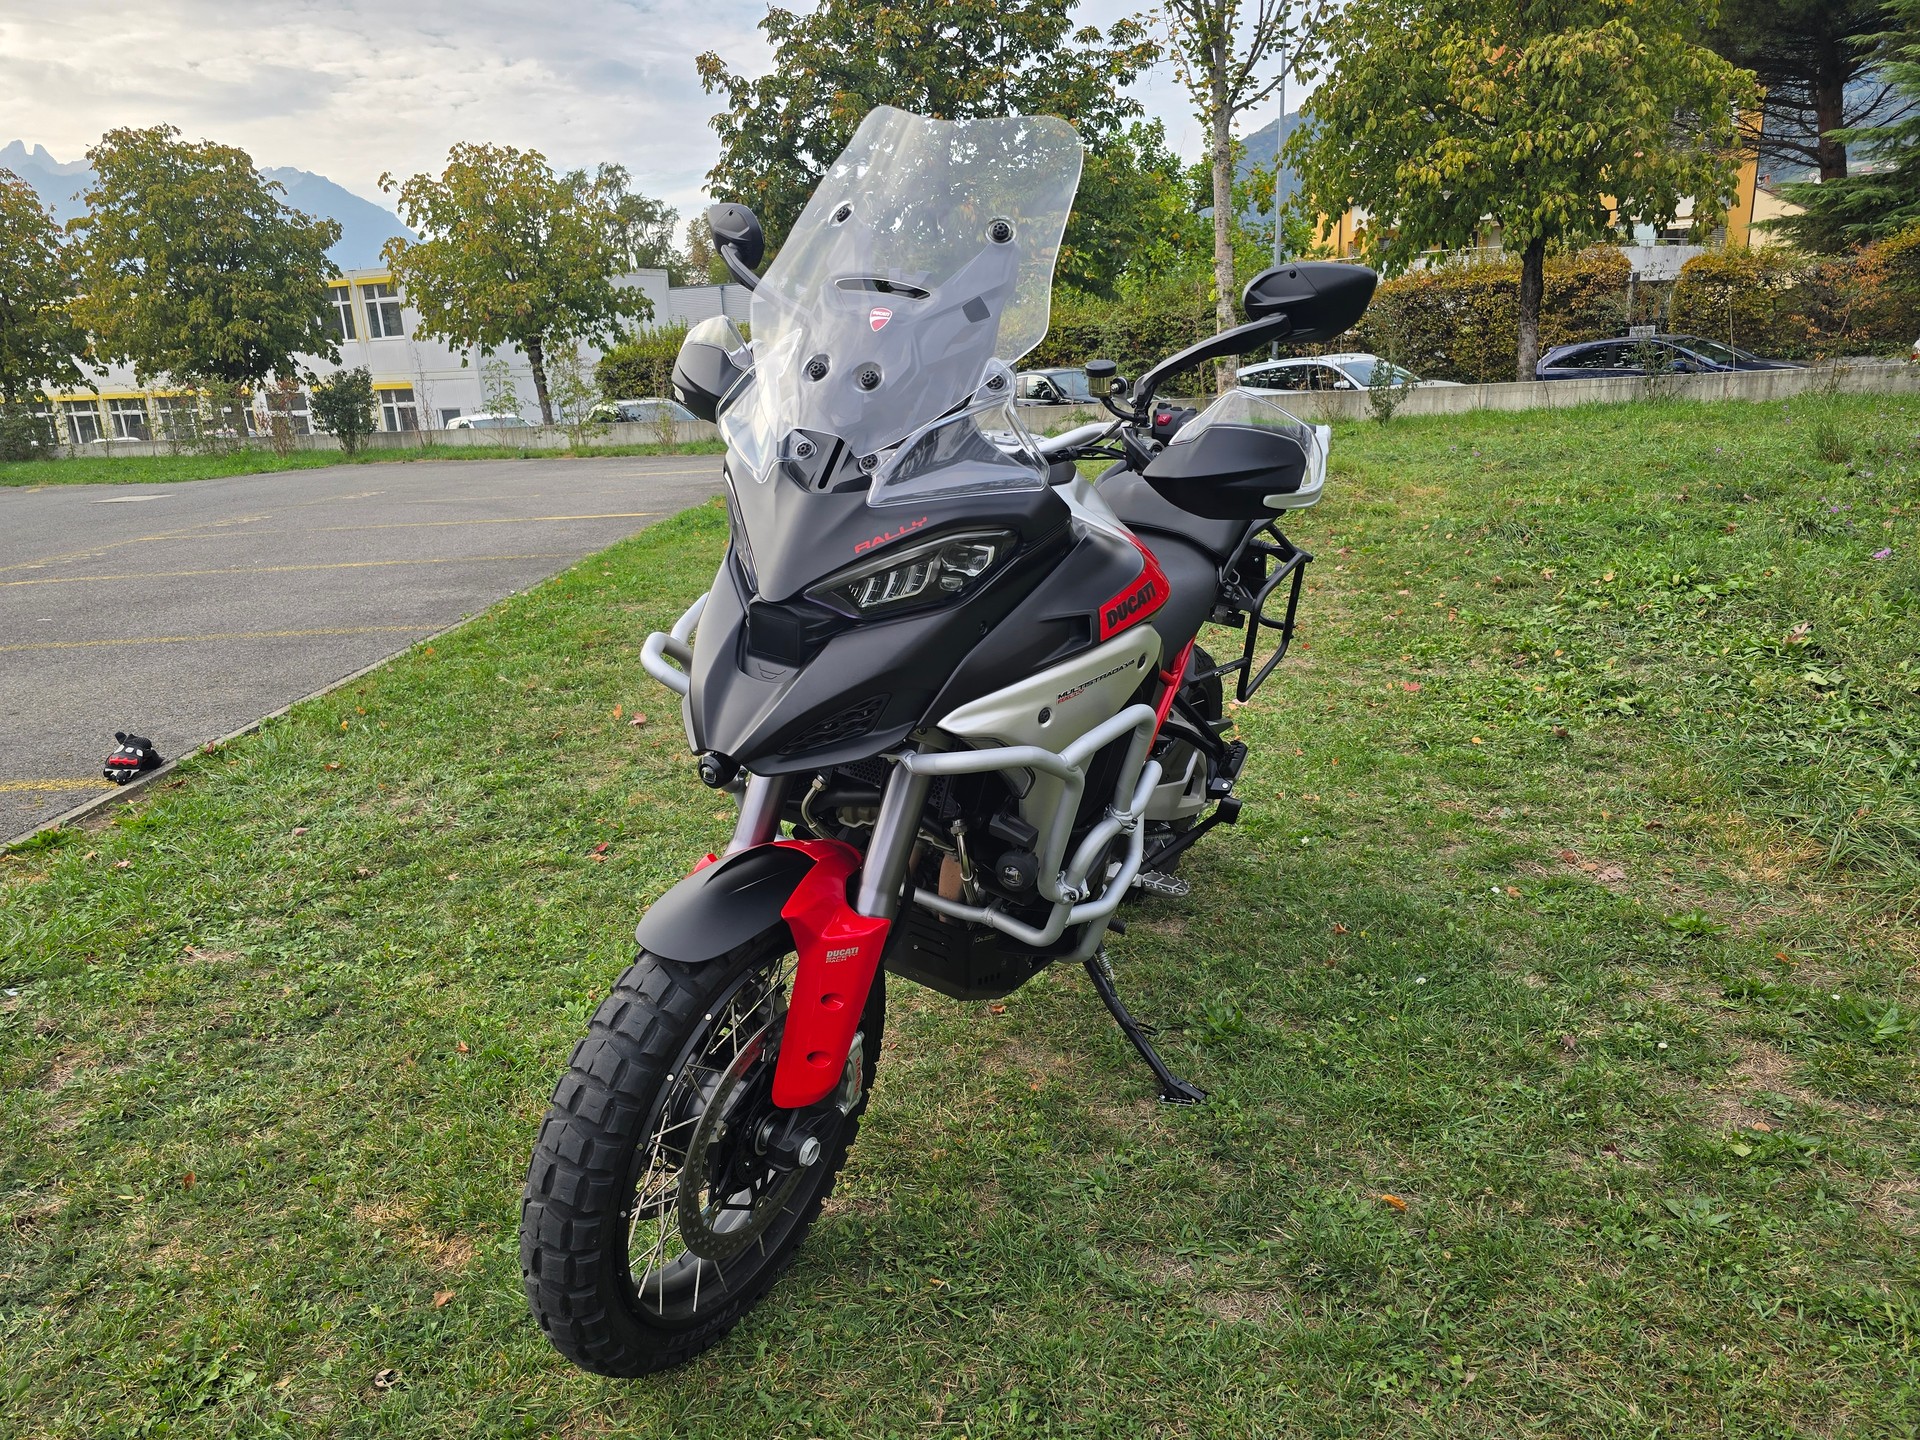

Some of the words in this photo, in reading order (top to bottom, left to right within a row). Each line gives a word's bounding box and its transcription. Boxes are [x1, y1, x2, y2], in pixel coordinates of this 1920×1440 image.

[854, 516, 928, 554] RALLY
[1105, 580, 1156, 629] DUCATI
[1057, 665, 1125, 699] MULTISTRADA
[826, 946, 859, 958] DUCATI
